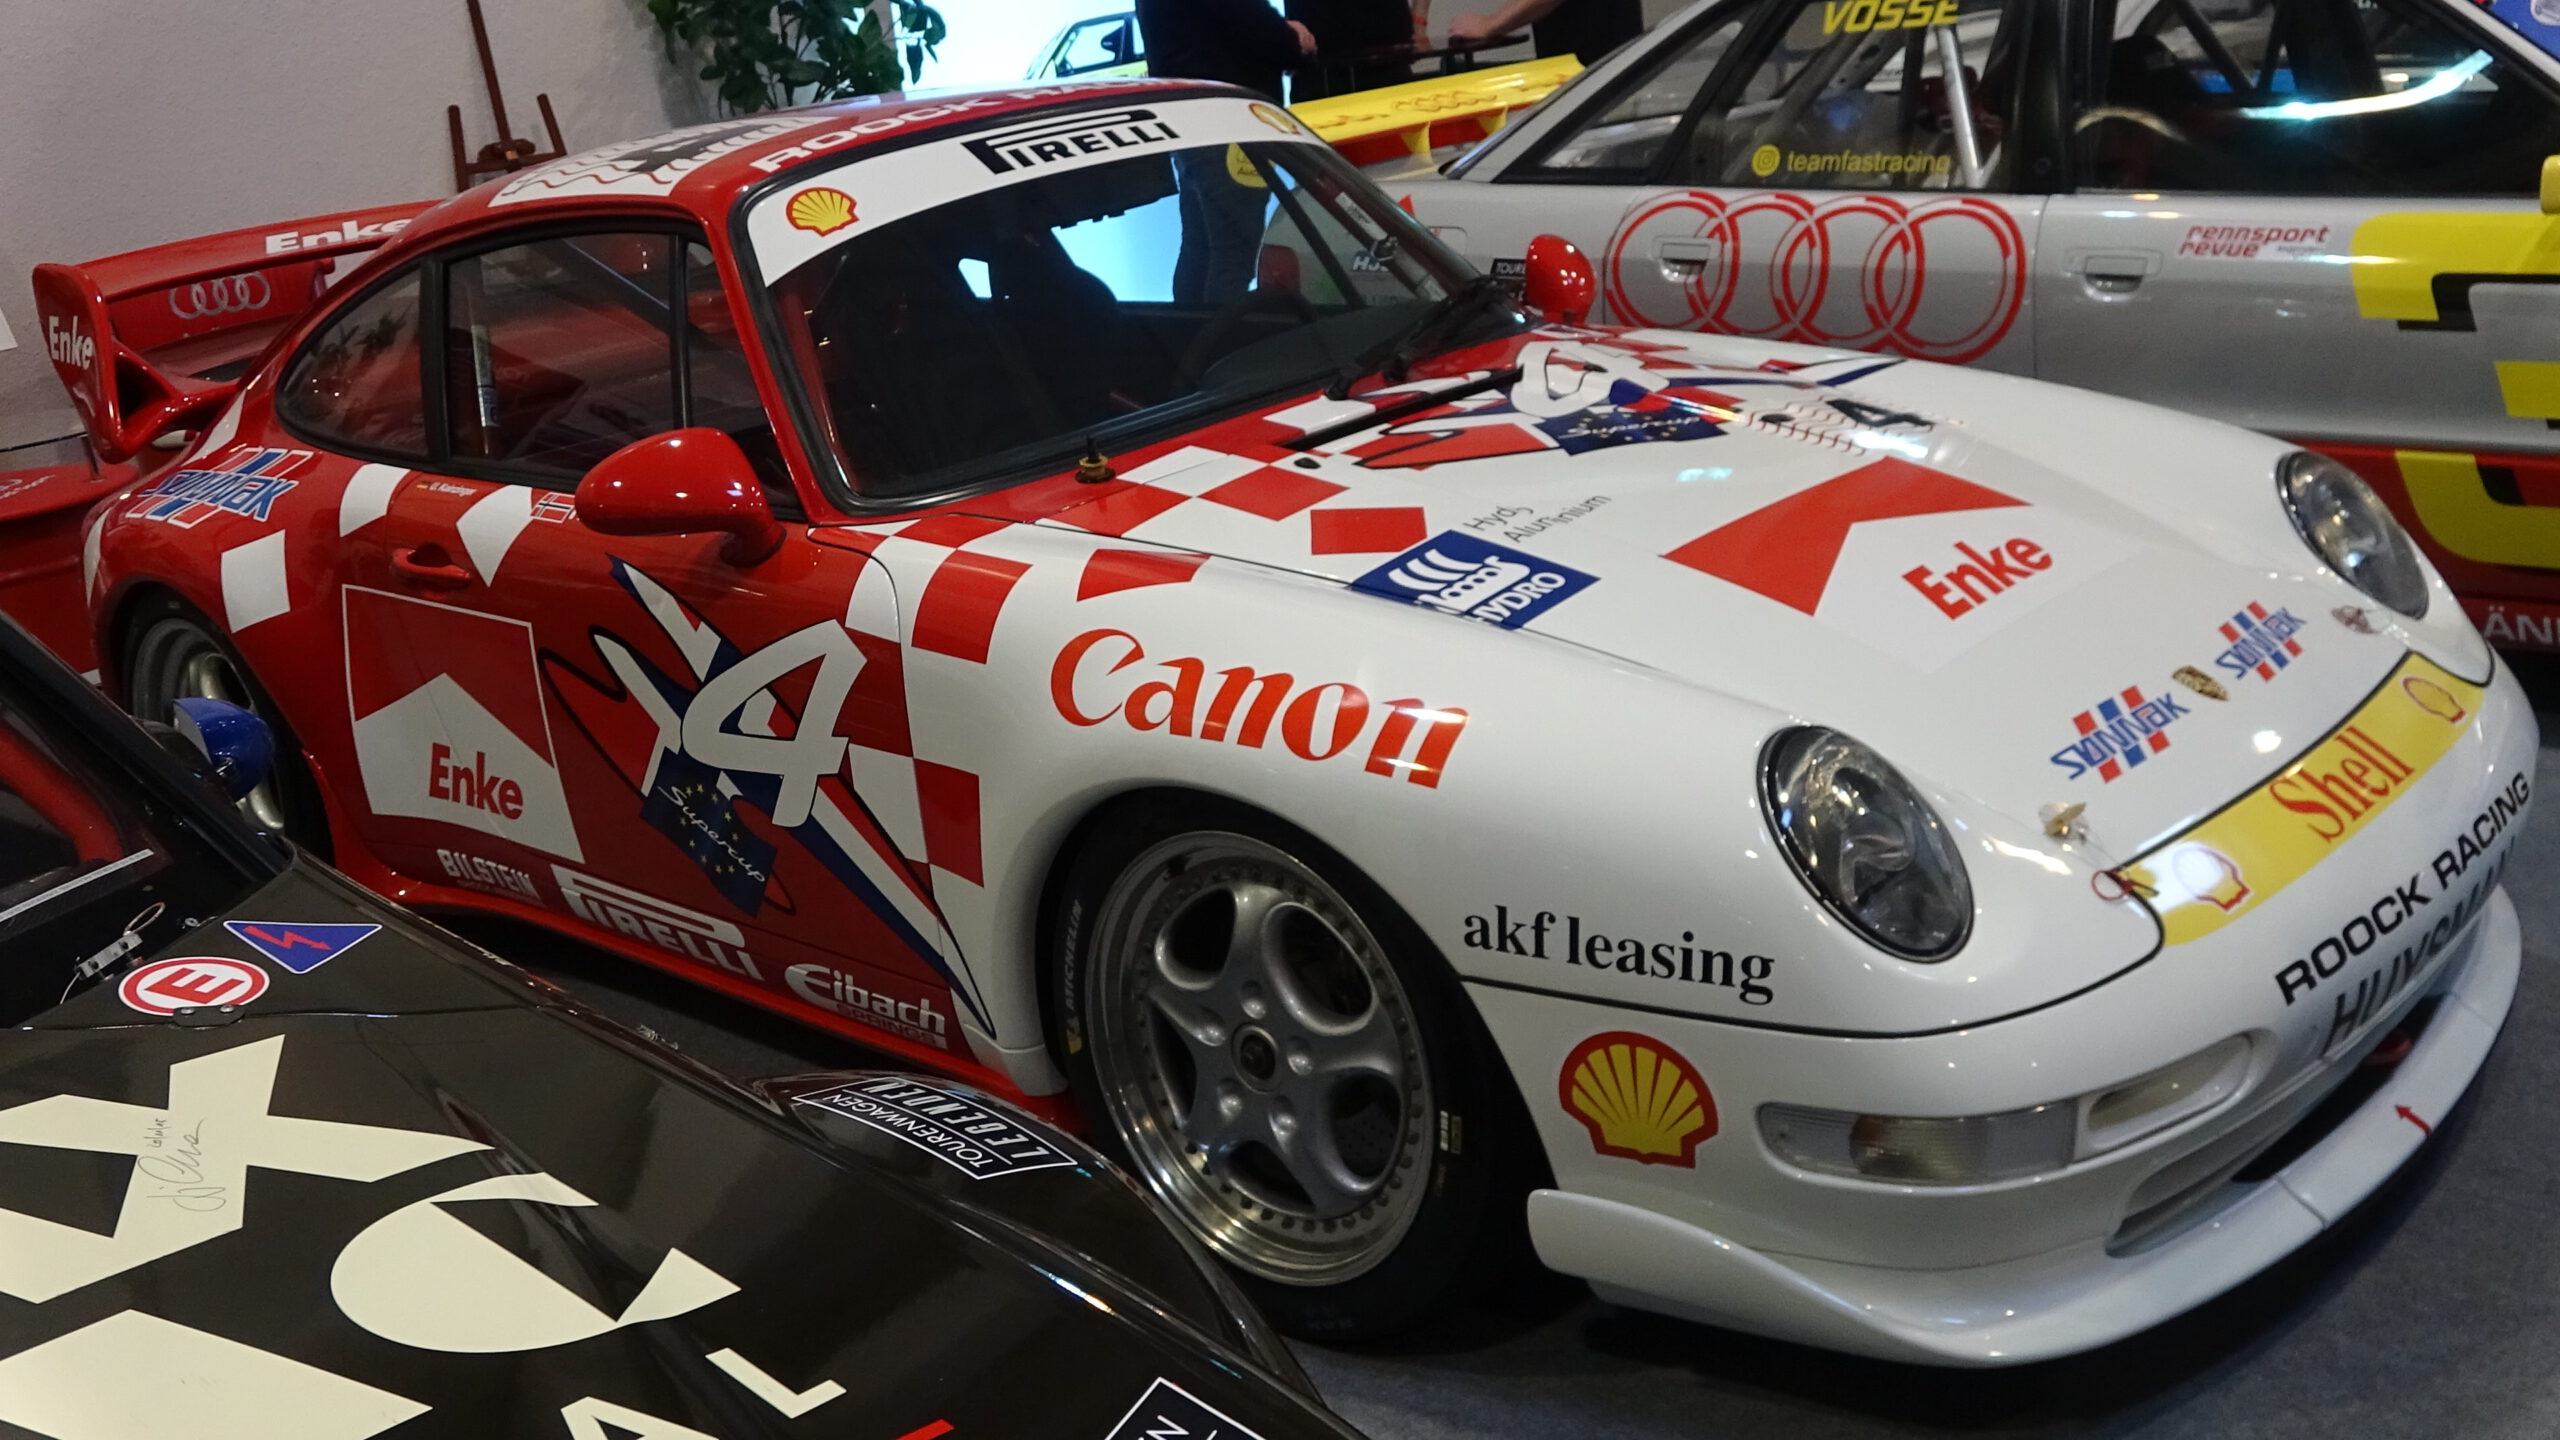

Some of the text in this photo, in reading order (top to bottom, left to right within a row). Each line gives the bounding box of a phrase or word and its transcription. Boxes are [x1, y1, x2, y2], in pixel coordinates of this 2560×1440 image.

[1824, 0, 1958, 35] VOSSE
[750, 97, 1002, 173] ROOCK
[961, 109, 1181, 174] PIRELLI
[1787, 150, 1951, 174] teamfastracing
[265, 218, 413, 254] Enke
[2178, 240, 2260, 257] revue
[2186, 224, 2331, 245] rennsport
[49, 316, 93, 370] Enke
[1463, 572, 1567, 622] HYDRO
[1902, 538, 2053, 620] Enke
[682, 618, 869, 829] 4
[1051, 628, 1470, 789] Canon
[429, 742, 524, 820] Enke
[2269, 725, 2415, 843] Shell
[657, 785, 766, 883] Supercup
[437, 848, 542, 899] BILSTEIN
[2275, 771, 2530, 1006] ROOCK RACING
[550, 863, 765, 982] PIRELLI
[1463, 904, 1775, 1006] akf leasing
[144, 966, 244, 1004] E
[784, 963, 946, 1034] Eibach
[821, 1093, 993, 1169] TOURENWAGEN
[861, 1080, 1050, 1160] LEGENDEN
